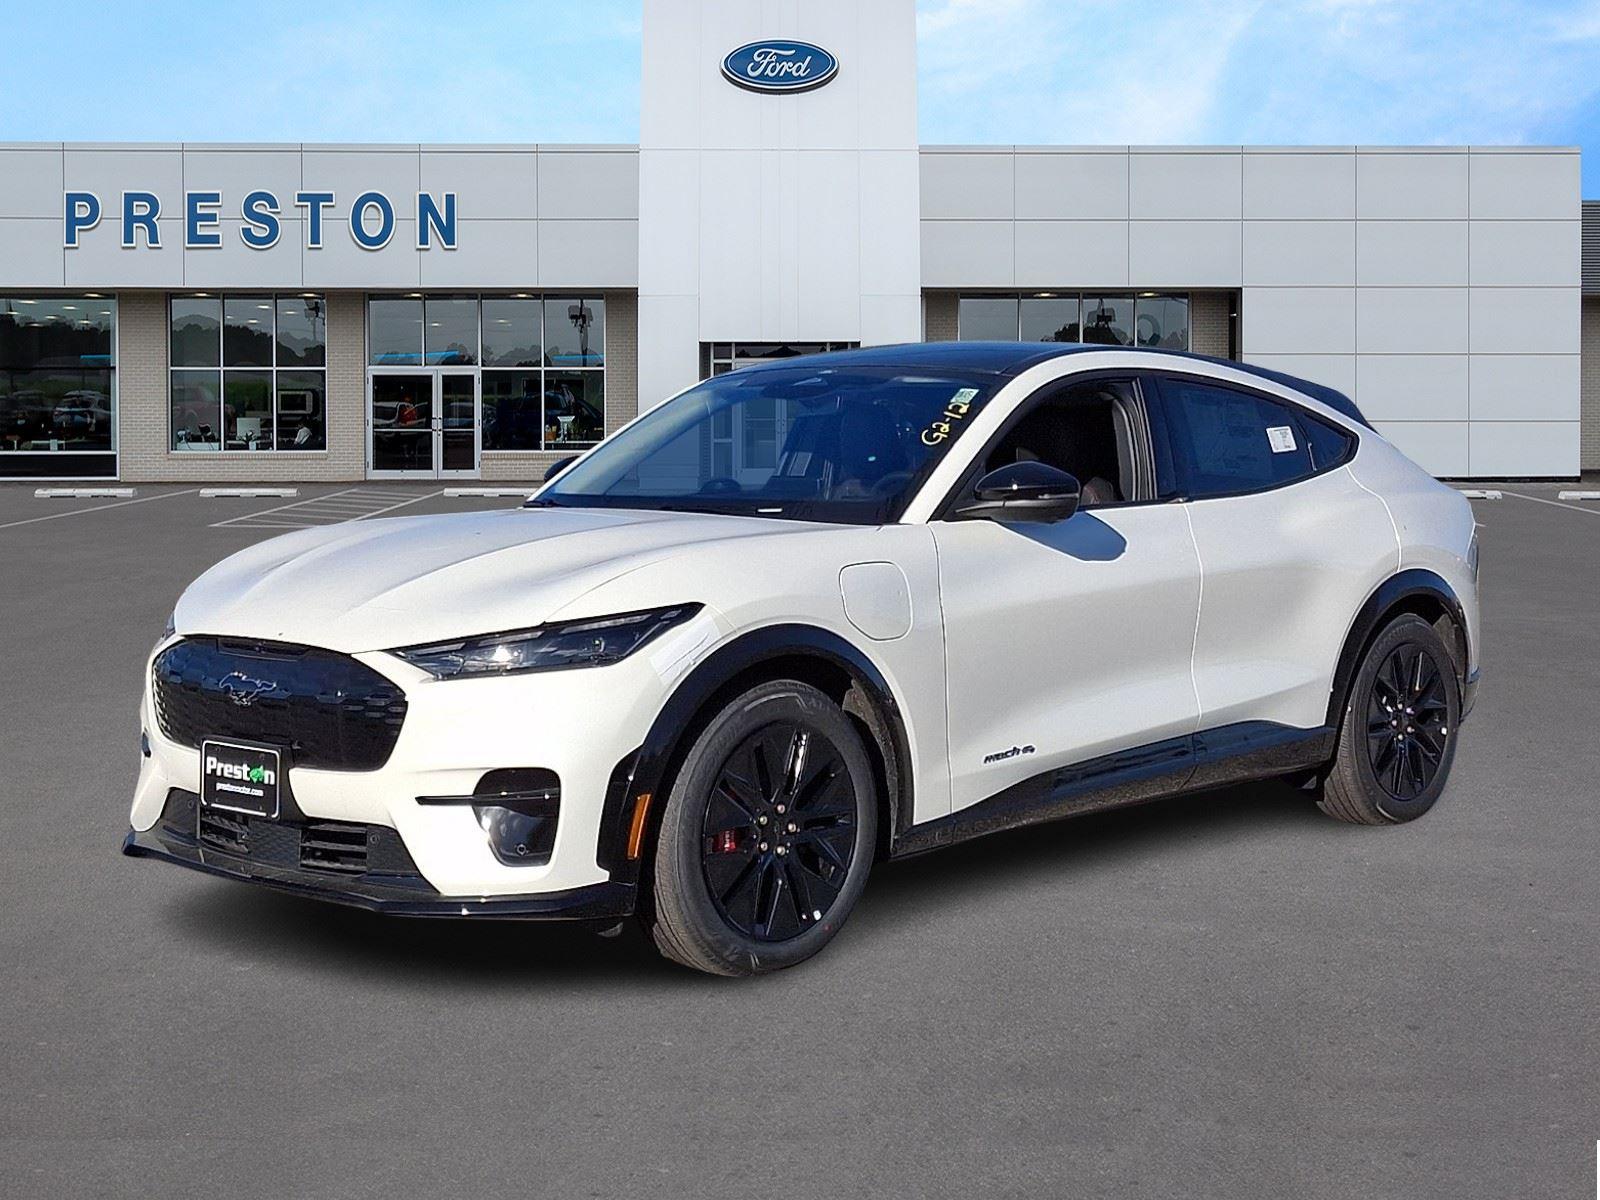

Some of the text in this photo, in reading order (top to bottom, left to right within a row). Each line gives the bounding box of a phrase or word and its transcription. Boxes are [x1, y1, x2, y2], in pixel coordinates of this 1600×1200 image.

[747, 48, 812, 77] Ford
[63, 190, 458, 250] PRESTON
[206, 756, 275, 785] Preston
